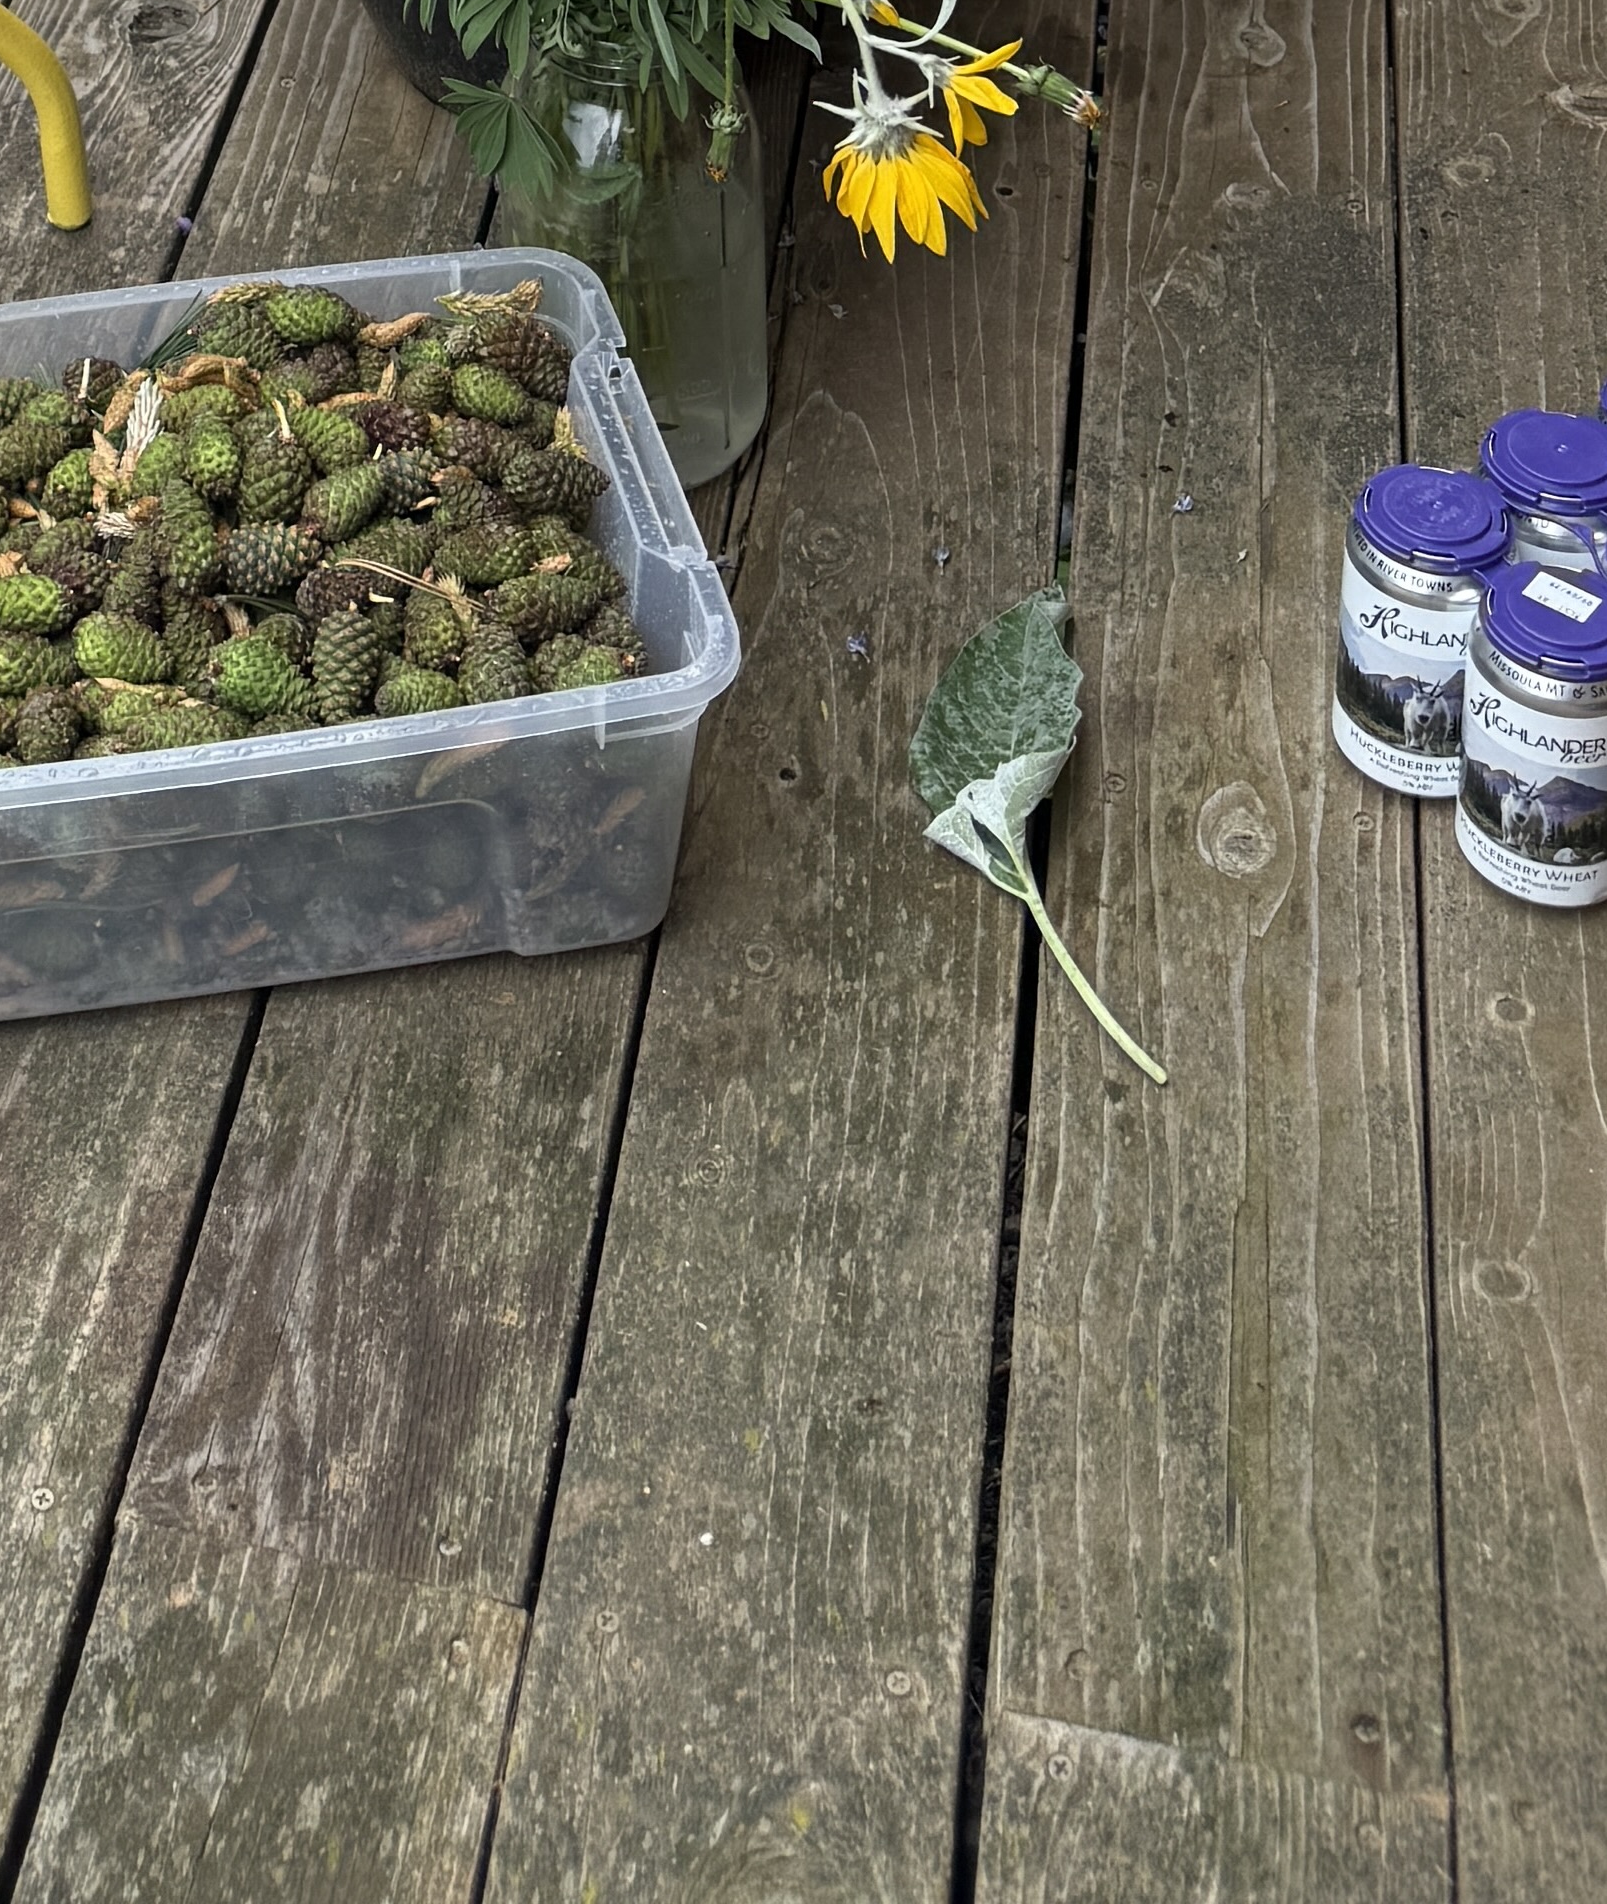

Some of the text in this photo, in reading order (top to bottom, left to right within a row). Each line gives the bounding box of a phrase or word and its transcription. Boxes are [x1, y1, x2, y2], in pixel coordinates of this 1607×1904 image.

[1366, 549, 1378, 564] IN
[1376, 559, 1407, 583] RIVER
[1410, 575, 1454, 593] TOWNS
[1359, 604, 1469, 648] HIGHLAN
[1488, 649, 1542, 693] MISSOULA
[1545, 680, 1567, 697] MT
[1590, 685, 1607, 698] SA
[1469, 692, 1606, 755] HIGHLANDER
[1350, 726, 1442, 773] HUCKLEBERRY
[1559, 748, 1607, 765] beer
[1460, 812, 1599, 883] HUCKLEBERRY WHEAT
